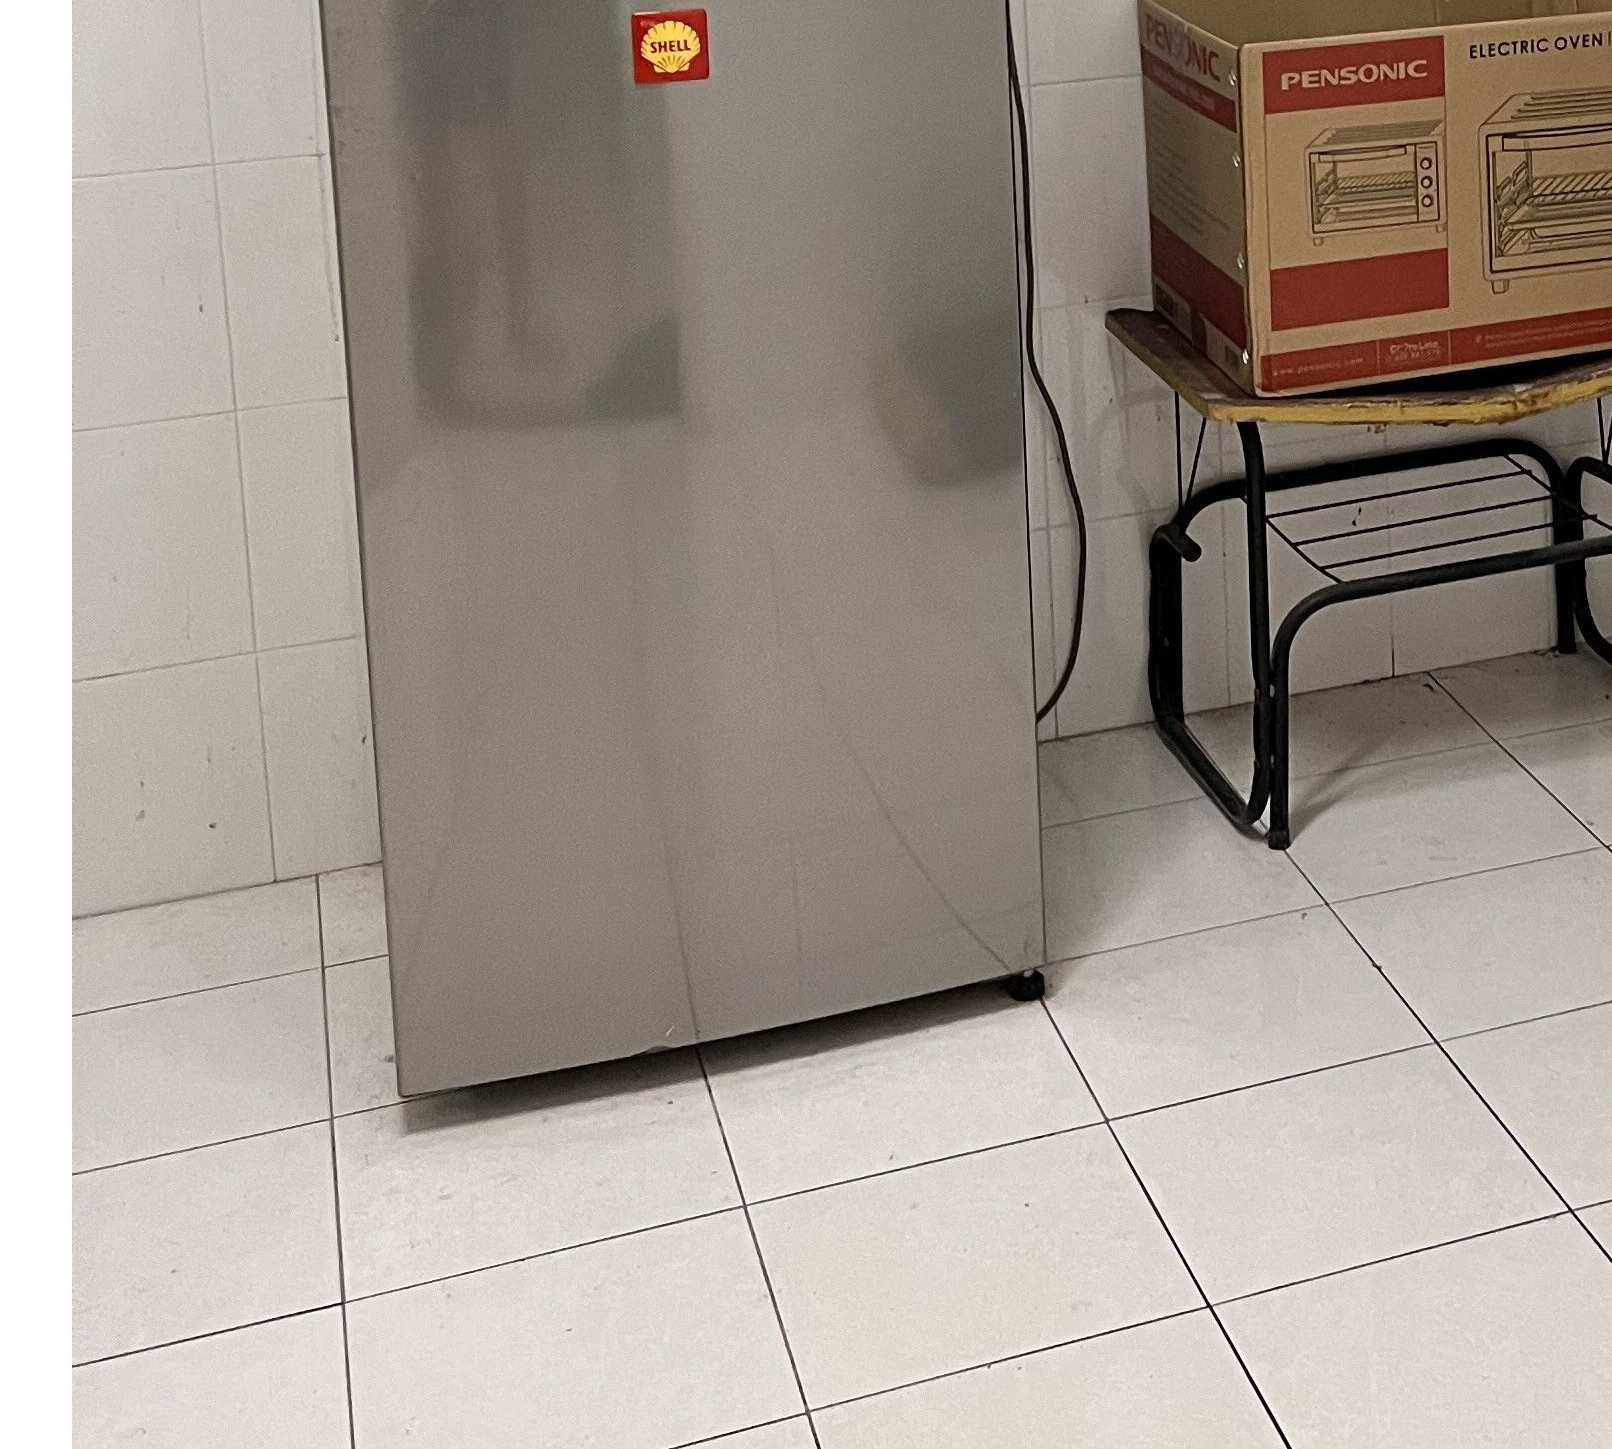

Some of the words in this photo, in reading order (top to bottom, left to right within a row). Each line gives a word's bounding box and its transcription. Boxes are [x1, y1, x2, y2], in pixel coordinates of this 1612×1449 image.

[650, 39, 692, 53] SHELL
[1469, 38, 1549, 59] ELECTRIC
[1554, 32, 1603, 51] OVEN
[1281, 59, 1428, 91] PENSONIC
